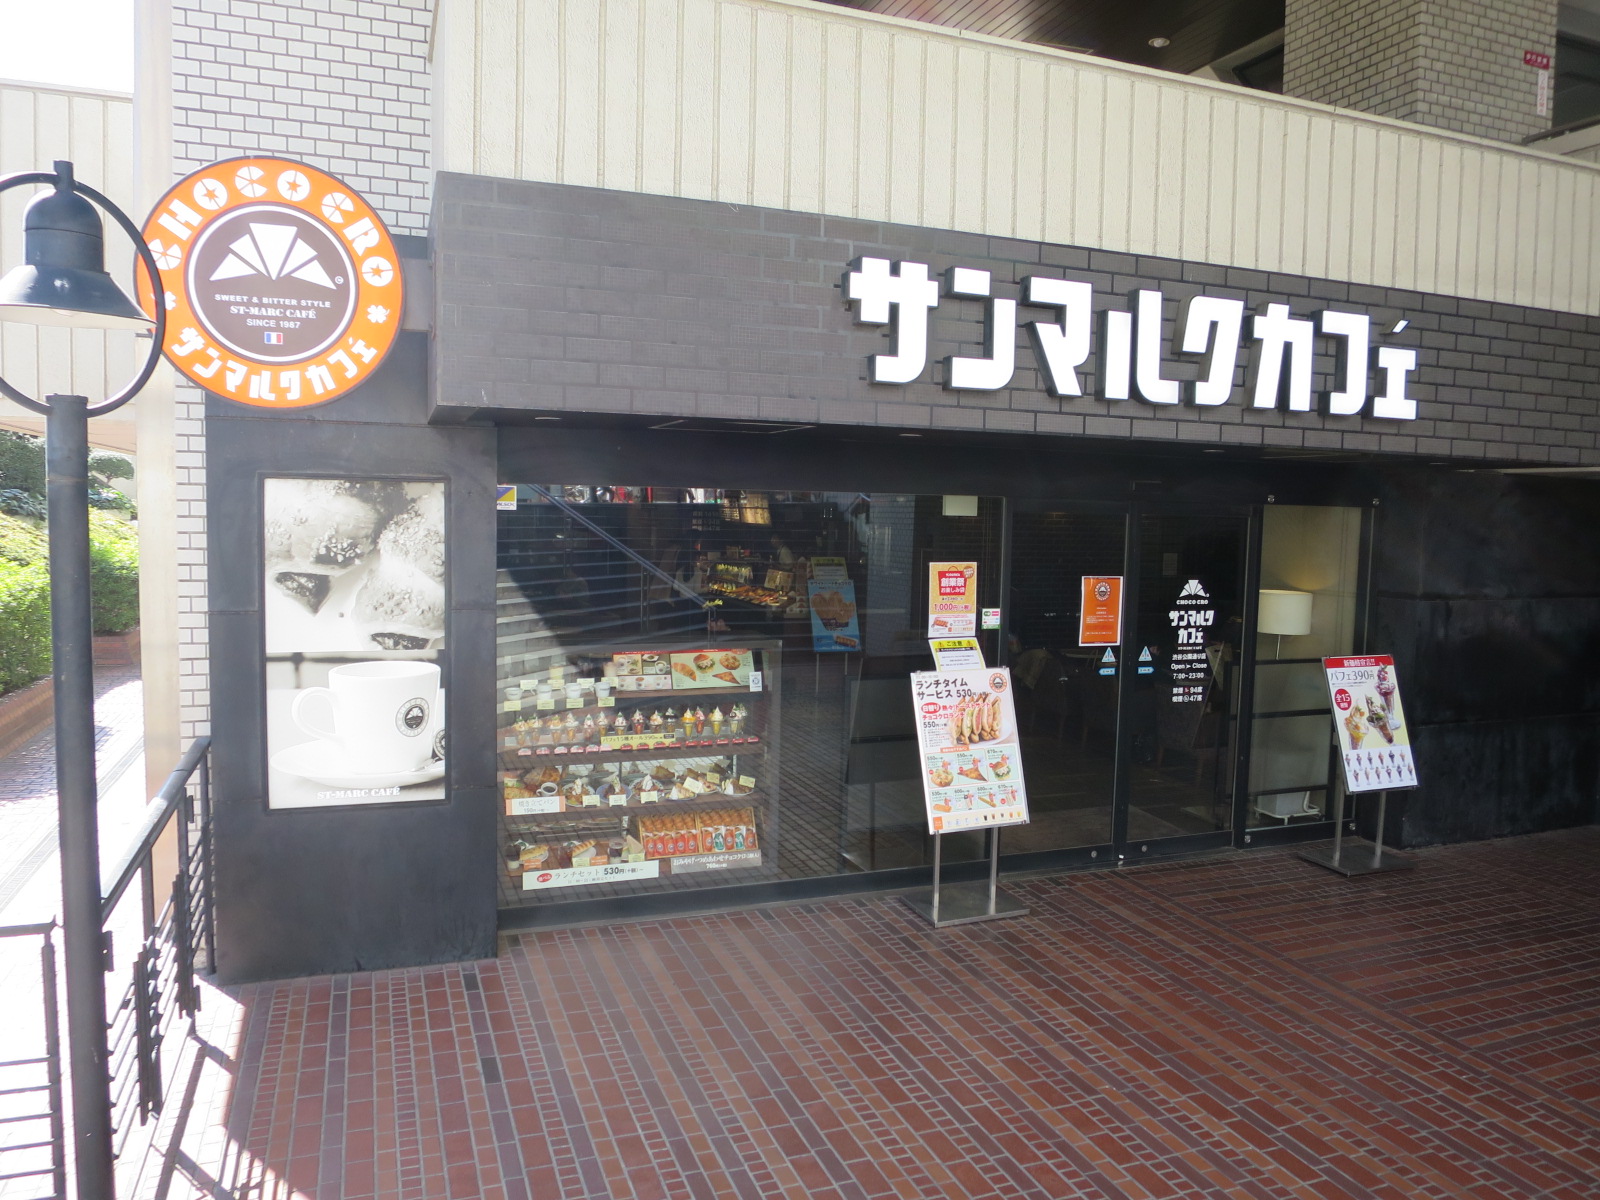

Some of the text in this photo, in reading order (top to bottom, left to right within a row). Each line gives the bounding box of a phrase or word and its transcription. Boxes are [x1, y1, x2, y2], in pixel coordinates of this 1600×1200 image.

[147, 166, 394, 287] CHOCO CRO
[214, 293, 331, 308] SWEET & BITTER STYLE
[229, 305, 317, 320] ST-MARC CAFÉ
[246, 318, 301, 329] SINCE 1987
[1168, 610, 1214, 626] サンマルク
[916, 678, 968, 689] ランチタイム
[917, 689, 953, 700] サービス
[922, 712, 965, 721] チョコクロランチ
[317, 790, 369, 800] ST-MARC
[554, 868, 600, 879] ランチセット
